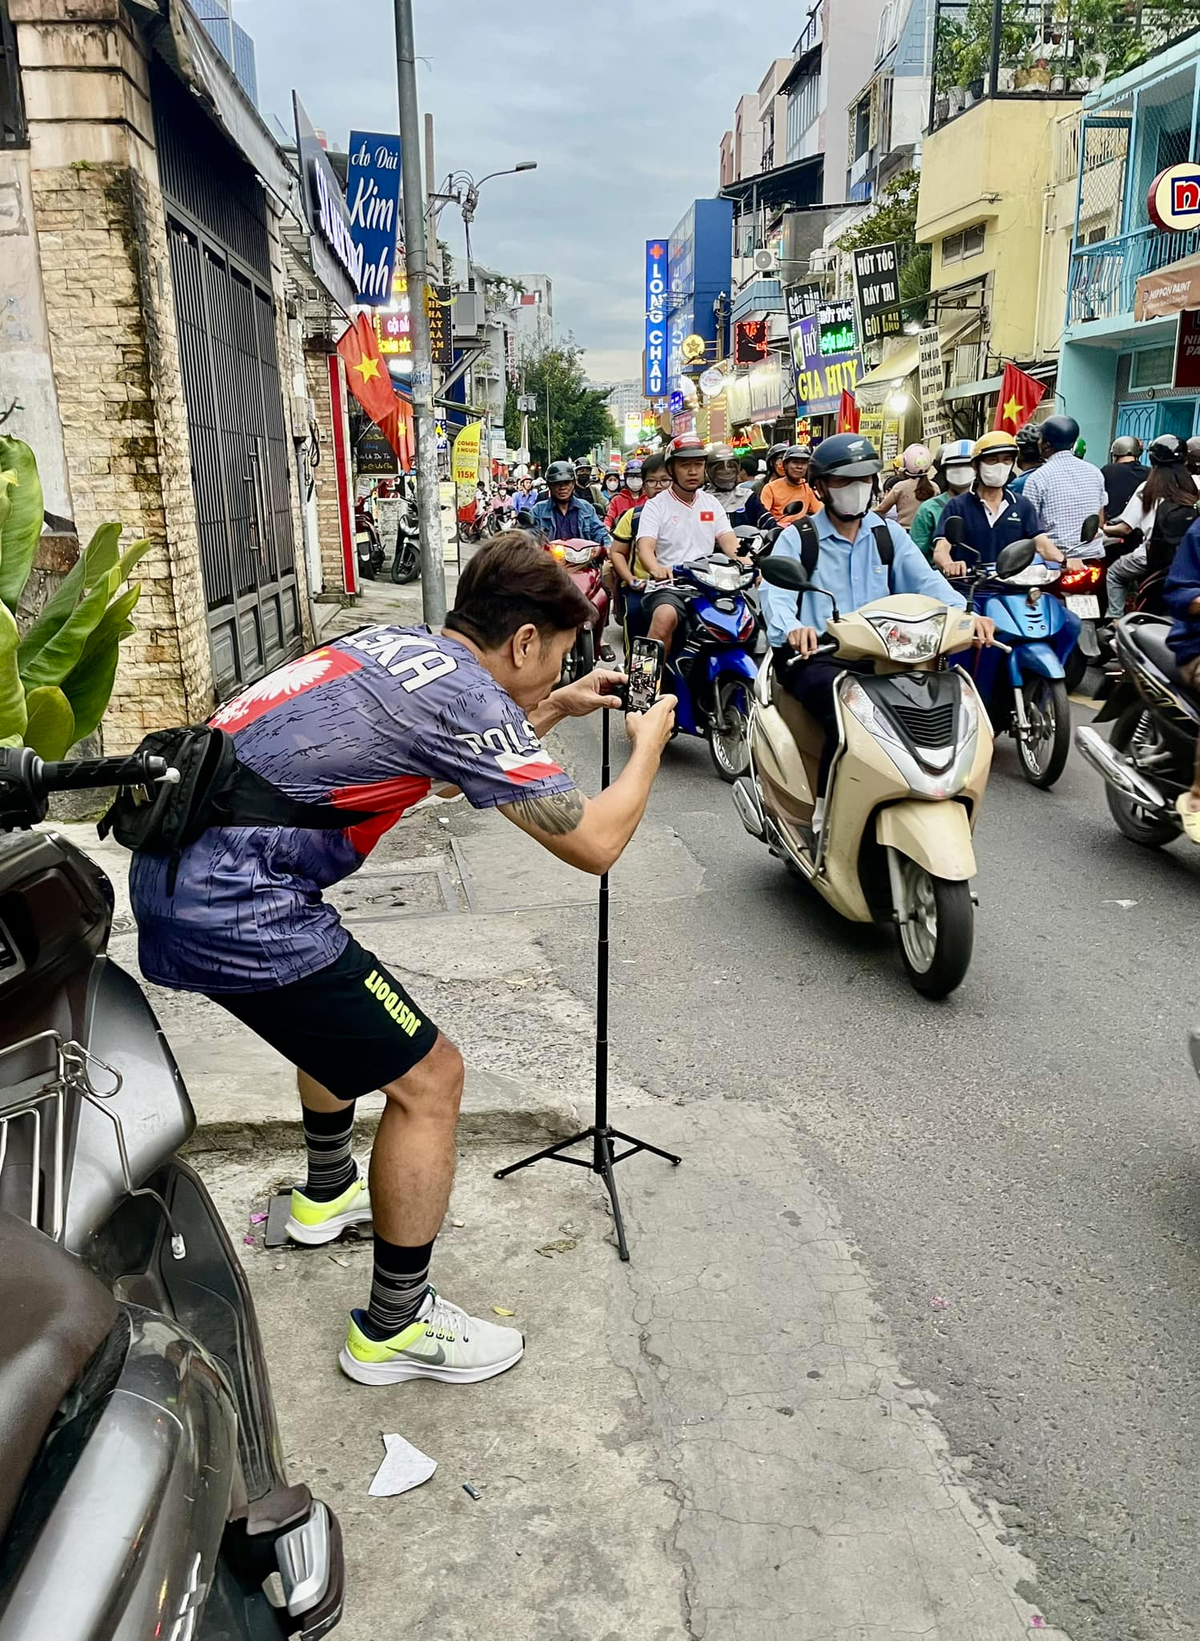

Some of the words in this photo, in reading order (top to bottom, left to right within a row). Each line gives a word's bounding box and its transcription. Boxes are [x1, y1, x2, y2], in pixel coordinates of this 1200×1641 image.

[351, 140, 371, 166] Áo
[375, 146, 398, 170] Dài
[351, 177, 394, 232] Kim
[876, 249, 895, 272] TÓC
[649, 264, 664, 324] LONG
[862, 284, 880, 306] RÁY
[881, 282, 895, 302] TAI
[649, 330, 663, 392] CHÂU
[798, 369, 824, 401] GIA
[825, 359, 858, 397] HUY
[456, 470, 475, 479] 115K
